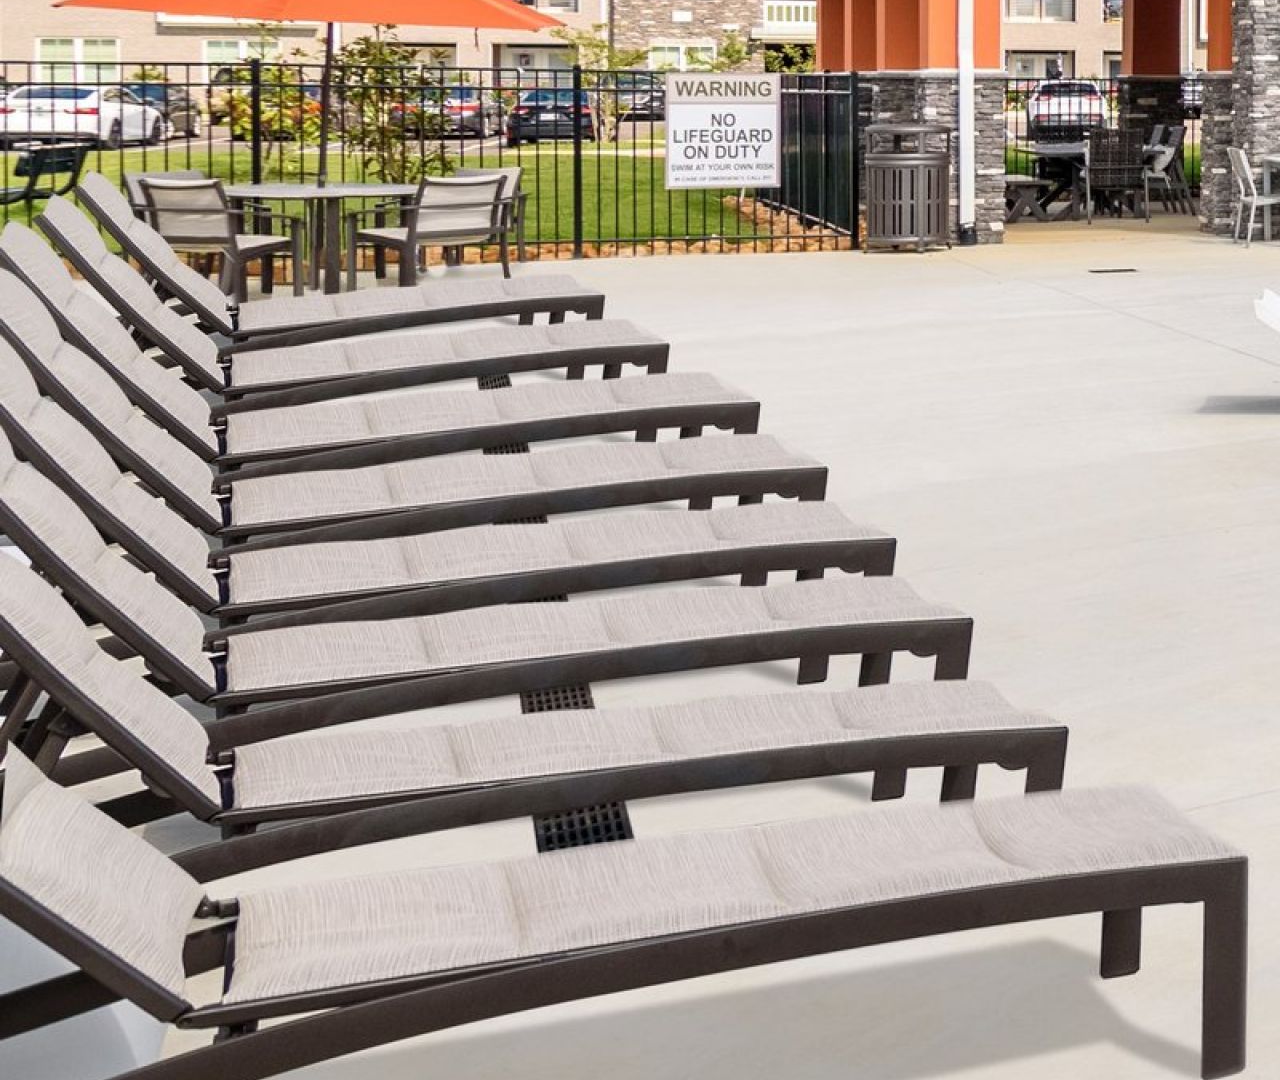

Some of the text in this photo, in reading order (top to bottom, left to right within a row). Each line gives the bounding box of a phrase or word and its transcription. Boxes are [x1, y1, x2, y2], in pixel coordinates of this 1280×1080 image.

[674, 81, 772, 97] WARNING
[711, 113, 737, 128] NO
[673, 129, 773, 144] LIFEGUARD
[684, 145, 762, 160] ON DUTY
[695, 163, 705, 171] AT
[708, 163, 732, 171] YOUR
[733, 163, 754, 171] OWN
[755, 163, 775, 171] RISK
